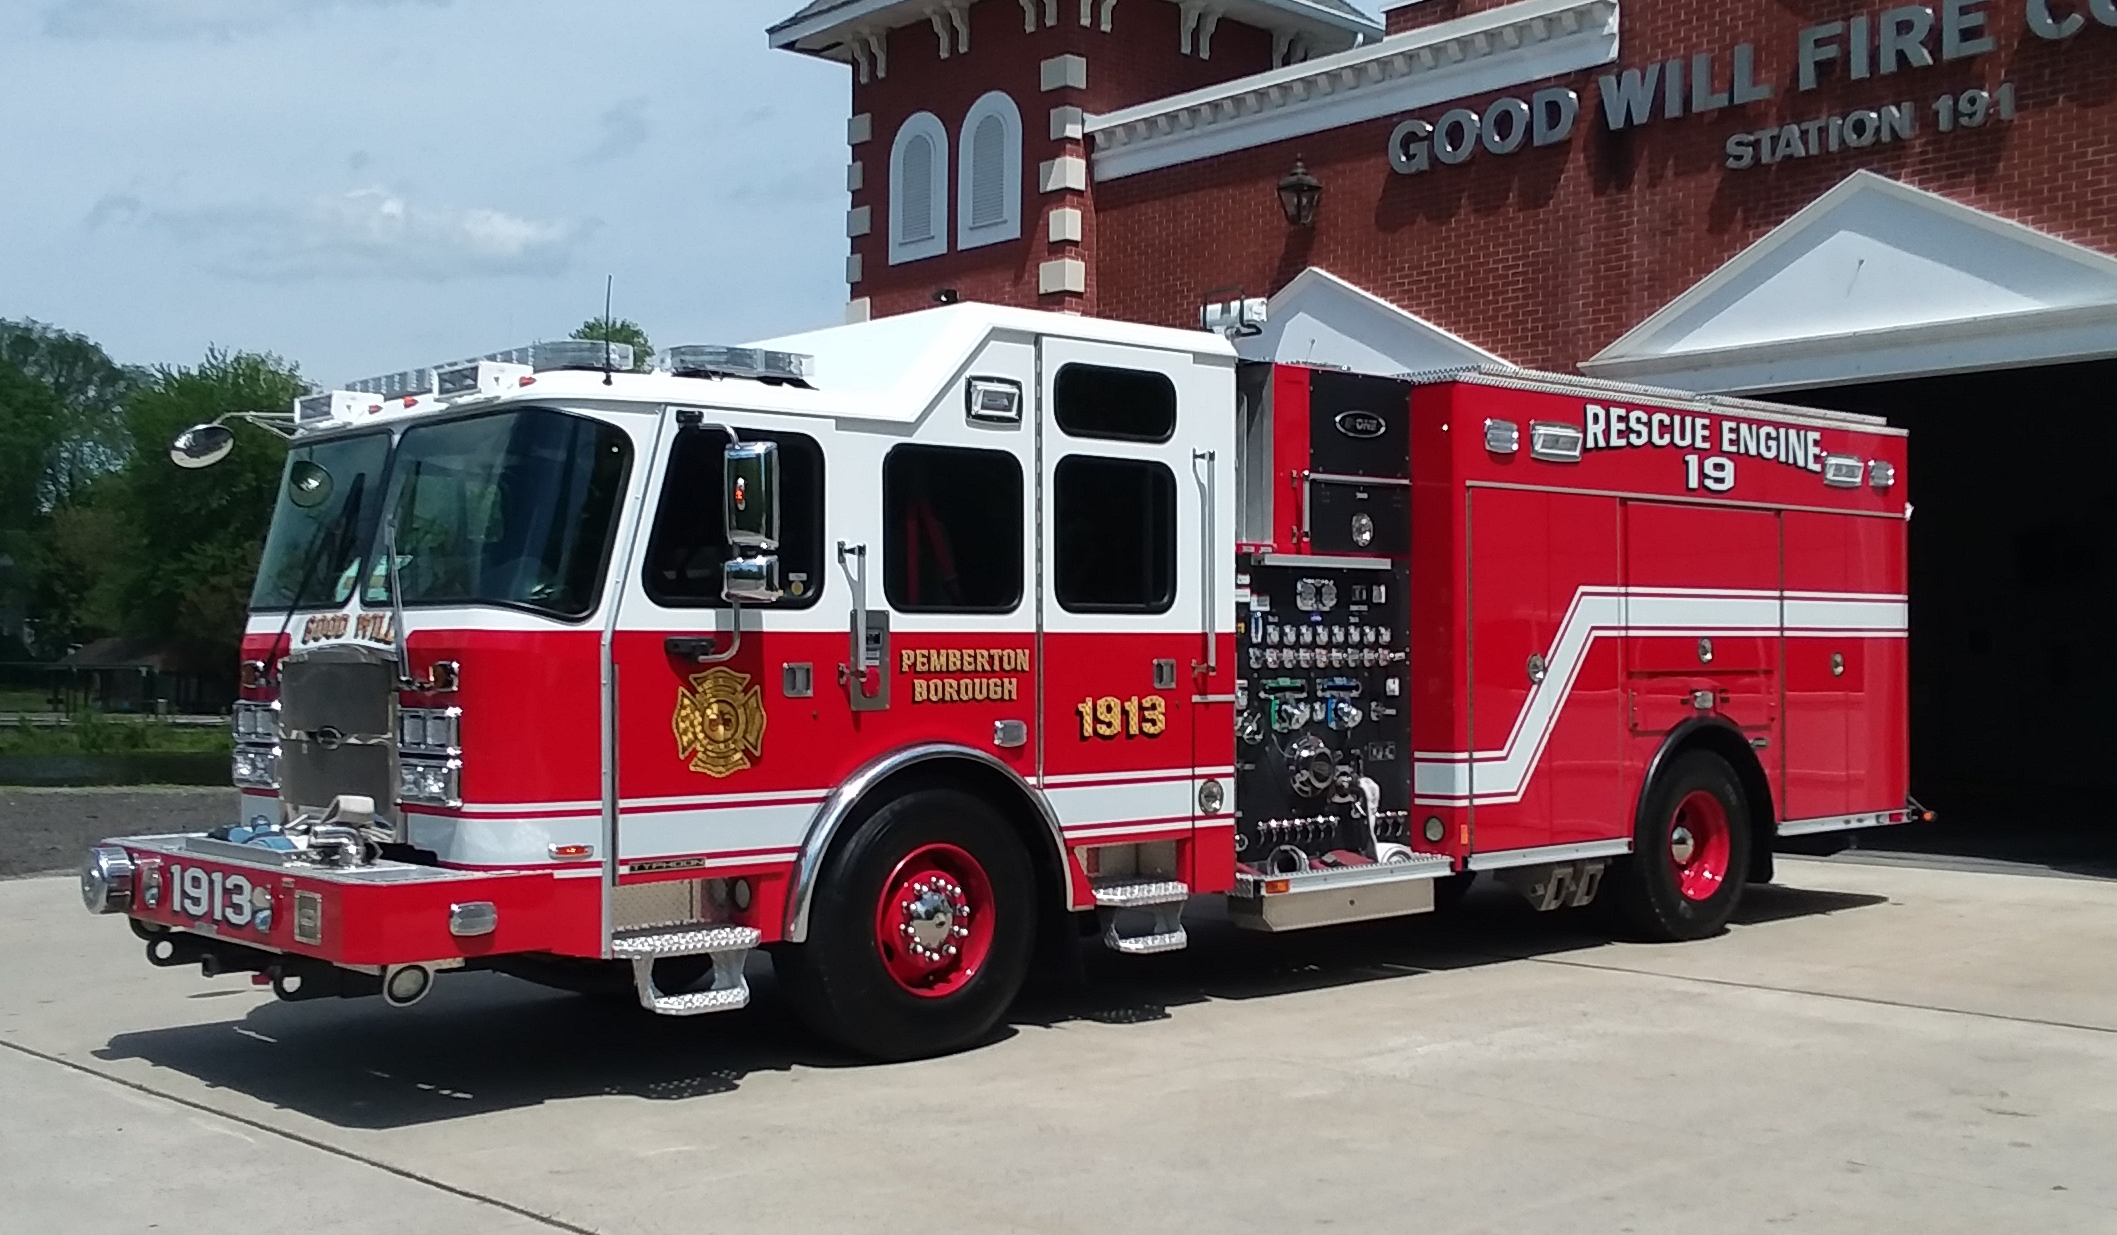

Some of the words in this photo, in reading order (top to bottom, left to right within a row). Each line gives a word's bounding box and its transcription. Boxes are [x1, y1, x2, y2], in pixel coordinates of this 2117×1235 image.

[1388, 87, 1579, 174] GOOD
[1599, 43, 1774, 131] WILL
[1799, 0, 1997, 91] FIRE
[1725, 102, 1915, 168] STATION
[1932, 83, 2015, 132] 191
[1583, 404, 1711, 449] RESCUE
[1720, 420, 1823, 472] ENGINE
[1684, 454, 1736, 491] 19
[302, 613, 350, 645] GOOD
[900, 649, 1030, 673] PEMBERTON
[912, 677, 1018, 703] BOROUGH
[1076, 695, 1166, 739] 1913
[631, 859, 704, 873] TYPHOON
[170, 863, 254, 926] 1913
